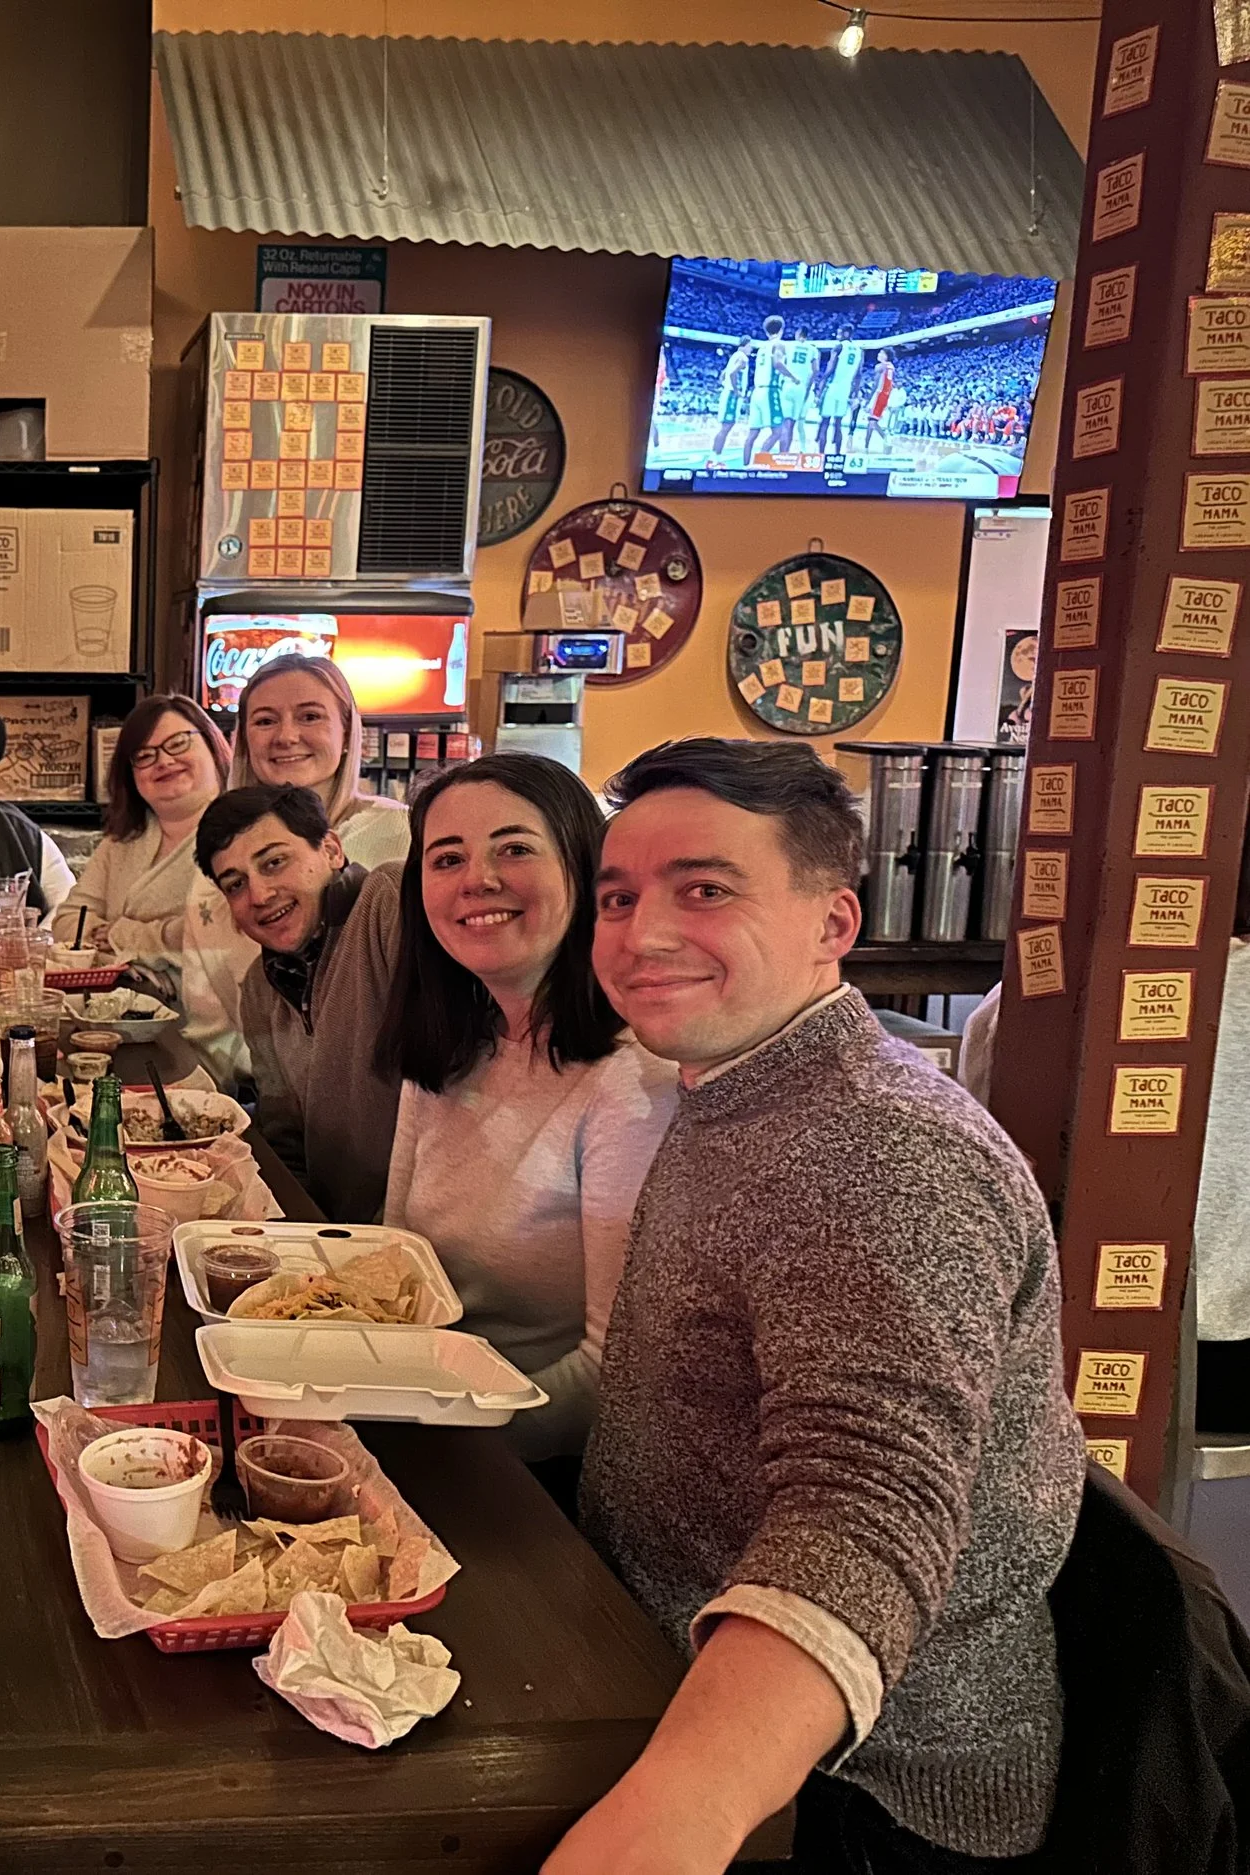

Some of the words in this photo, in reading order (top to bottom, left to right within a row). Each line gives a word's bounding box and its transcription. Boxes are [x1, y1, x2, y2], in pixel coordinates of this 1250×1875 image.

[1117, 66, 1143, 83] MAMA
[1233, 98, 1250, 115] Ta
[1231, 121, 1250, 134] MA
[1105, 193, 1130, 210] MAMA
[263, 249, 277, 260] 32
[300, 249, 362, 261] Returnable
[263, 261, 288, 273] With
[291, 261, 328, 274] Reseal
[330, 262, 361, 276] Caps
[287, 282, 335, 299] NOW
[337, 284, 355, 299] IN
[275, 299, 366, 314] CARTONS
[1099, 301, 1122, 317] MAMA
[1206, 332, 1243, 345] MAMA
[792, 351, 807, 365] 15
[489, 383, 544, 430] OLD
[1084, 414, 1109, 431] MAMA
[1215, 414, 1250, 427] MAMA
[849, 457, 864, 469] 63
[1203, 508, 1239, 520] MAMA
[1073, 520, 1096, 535] MAMA
[1065, 608, 1089, 622] MAMA
[1182, 613, 1218, 625] MAMA
[777, 620, 845, 658] FUN
[1062, 699, 1084, 713] MAMA
[1168, 713, 1203, 725] MAMA
[1040, 795, 1062, 808] MAMA
[1154, 818, 1191, 831] MAMA
[1033, 881, 1056, 893] MAMA
[1149, 908, 1185, 922] MAMA
[1030, 956, 1053, 970] MAMA
[1138, 1003, 1175, 1015] MAMA
[1129, 1096, 1165, 1109] MAMA
[1114, 1272, 1149, 1285] MAMA
[1091, 1380, 1126, 1392] MAMA
[1087, 1449, 1113, 1463] aCO
